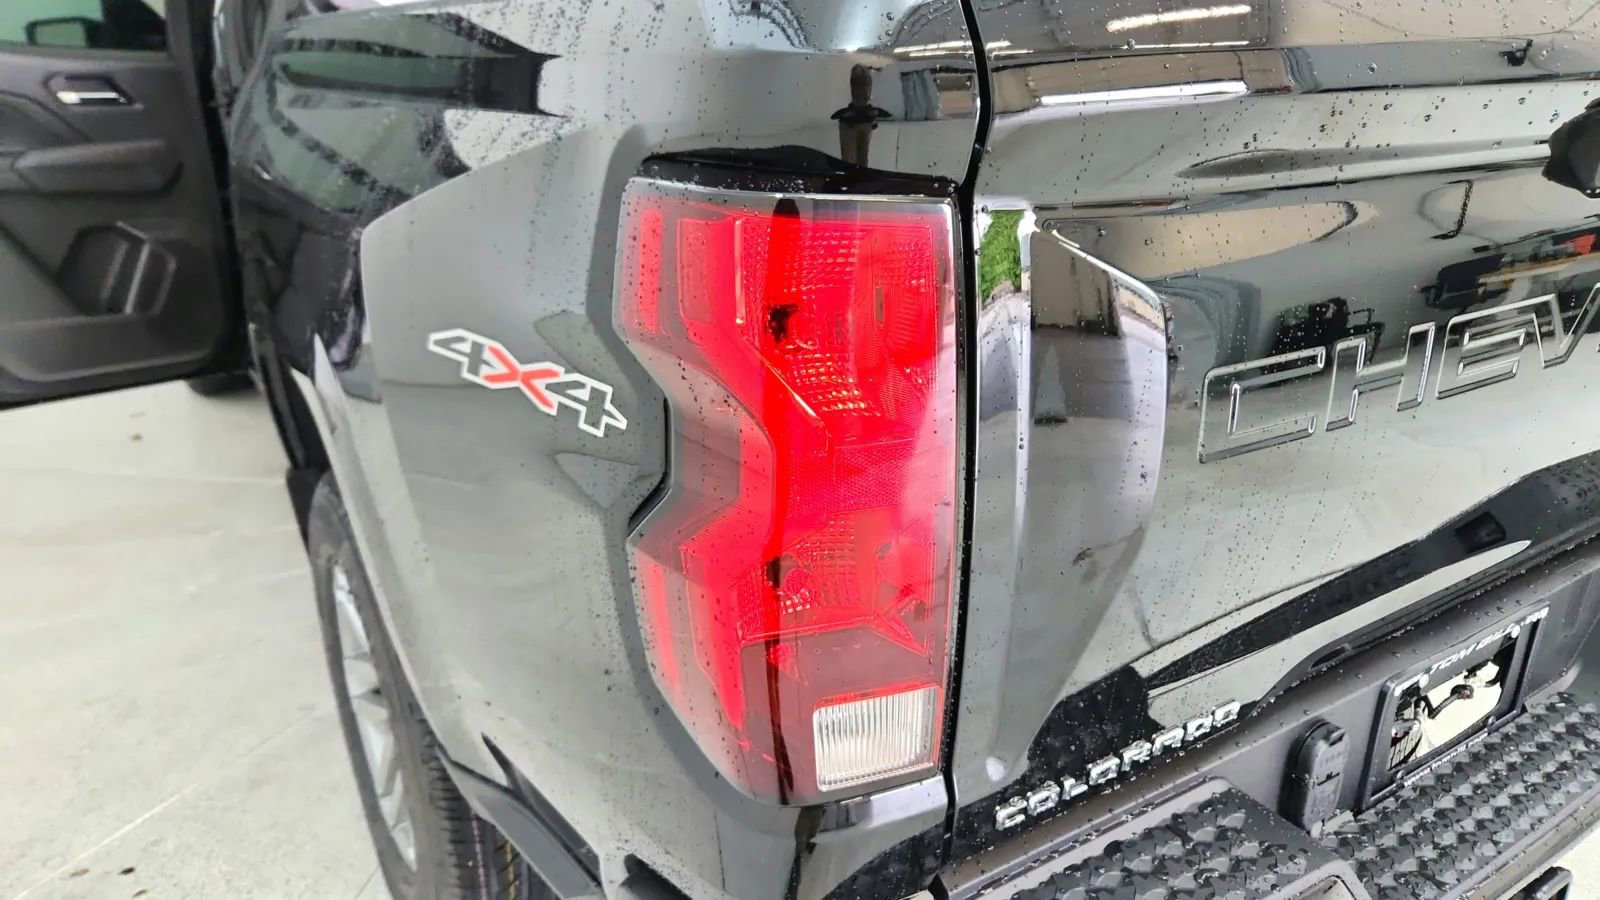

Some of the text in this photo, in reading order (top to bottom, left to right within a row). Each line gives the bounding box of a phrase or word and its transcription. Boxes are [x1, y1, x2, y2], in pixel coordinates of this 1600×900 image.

[1197, 282, 1600, 464] CHEV
[1429, 642, 1477, 675] TOM
[994, 699, 1241, 831] COLORADO
